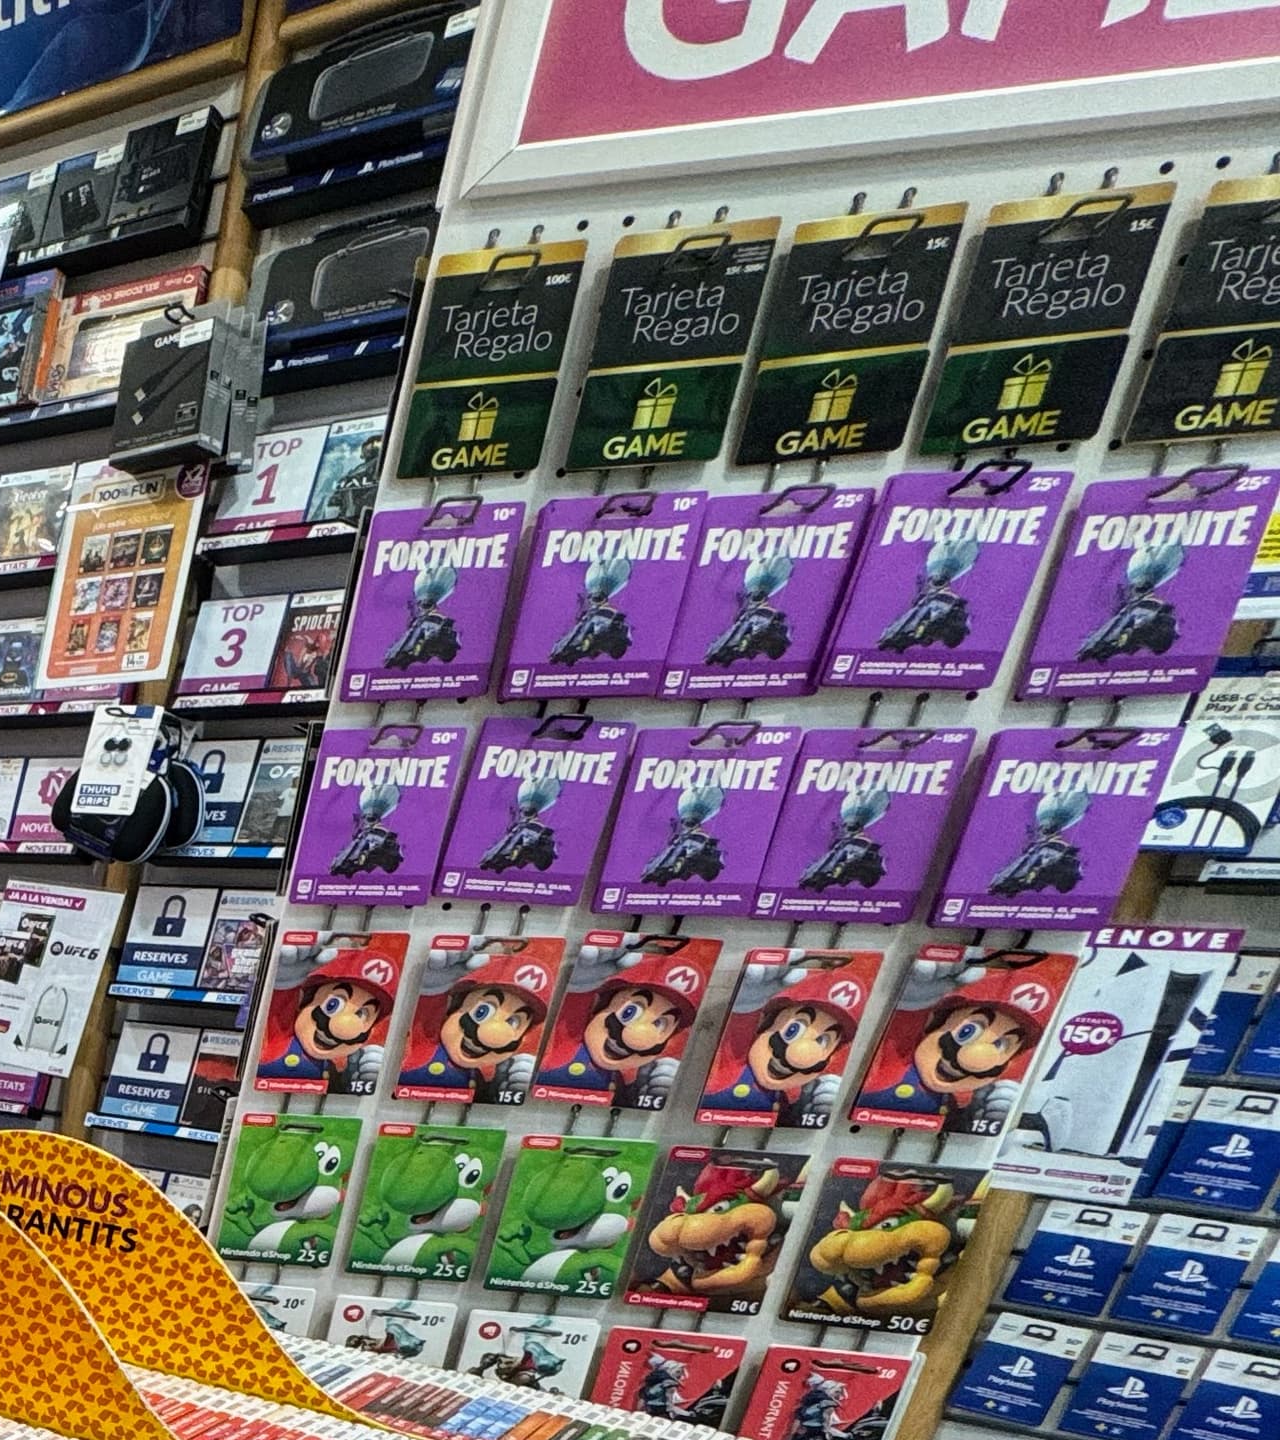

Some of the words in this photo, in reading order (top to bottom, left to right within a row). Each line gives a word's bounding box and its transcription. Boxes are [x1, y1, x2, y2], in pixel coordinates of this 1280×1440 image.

[1129, 216, 1157, 232] 15€
[925, 236, 951, 251] 15€
[545, 272, 572, 287] 100€
[989, 250, 1112, 292] Tarjeta
[797, 267, 910, 310] Tarjeta
[620, 283, 727, 322] Tarjeta
[1000, 277, 1127, 321] Regalo
[441, 300, 540, 336] Tarjeta
[807, 293, 927, 335] Regalo
[631, 306, 743, 347] Regalo
[453, 325, 554, 362] Regalo
[961, 410, 1059, 445] GAME
[256, 437, 303, 457] TOP
[602, 429, 687, 461] GAME
[774, 422, 865, 455] GAME
[430, 443, 510, 473] GAME
[130, 480, 159, 497] FUN
[251, 464, 279, 506] 1
[879, 505, 1048, 547] FORTNITE
[1074, 505, 1258, 557] FORTNITE
[542, 523, 690, 568] FORTNITE
[700, 520, 851, 565] FORTNITE
[372, 533, 510, 577] FORTNITE
[221, 603, 265, 623] TOP
[215, 628, 248, 668] 3
[1204, 702, 1236, 715] Play
[320, 755, 450, 790] FORTNITE
[478, 745, 618, 786] FORTNITE
[635, 757, 782, 793] FORTNITE
[796, 758, 954, 796] FORTNITE
[988, 760, 1158, 798] FORTNITE
[82, 784, 120, 795] THUMB
[79, 796, 110, 806] GRIPS
[64, 946, 90, 958] UFC
[88, 948, 100, 960] 6
[132, 951, 189, 964] RESERVES
[137, 969, 175, 982] GAME
[110, 985, 155, 997] RESERVES
[118, 1084, 171, 1099] RESERVES
[350, 1080, 374, 1094] 15€
[498, 1090, 523, 1104] 15€
[637, 1095, 663, 1109] 15€
[121, 1102, 158, 1117] GAME
[86, 1115, 129, 1128] RESERVES
[801, 1113, 827, 1127] 15€
[971, 1119, 1000, 1134] 15€
[1088, 1184, 1127, 1198] GAME
[220, 1246, 261, 1259] Nintendo
[261, 1249, 291, 1261] eShop
[296, 1249, 329, 1264] 25€
[351, 1260, 395, 1273] Nintendo
[395, 1263, 427, 1276] eShop
[433, 1263, 468, 1279] 25€
[489, 1276, 535, 1291] Nintendo
[537, 1280, 570, 1293] eShop
[575, 1280, 612, 1296] 25€
[282, 1296, 306, 1309] 10€
[730, 1300, 760, 1314] 50€
[422, 1313, 447, 1326] 10€
[789, 1310, 841, 1326] Nintendo
[842, 1314, 881, 1328] eShop
[887, 1315, 930, 1333] 50€
[562, 1331, 589, 1346] 10€
[759, 1380, 790, 1439] VALORANT
